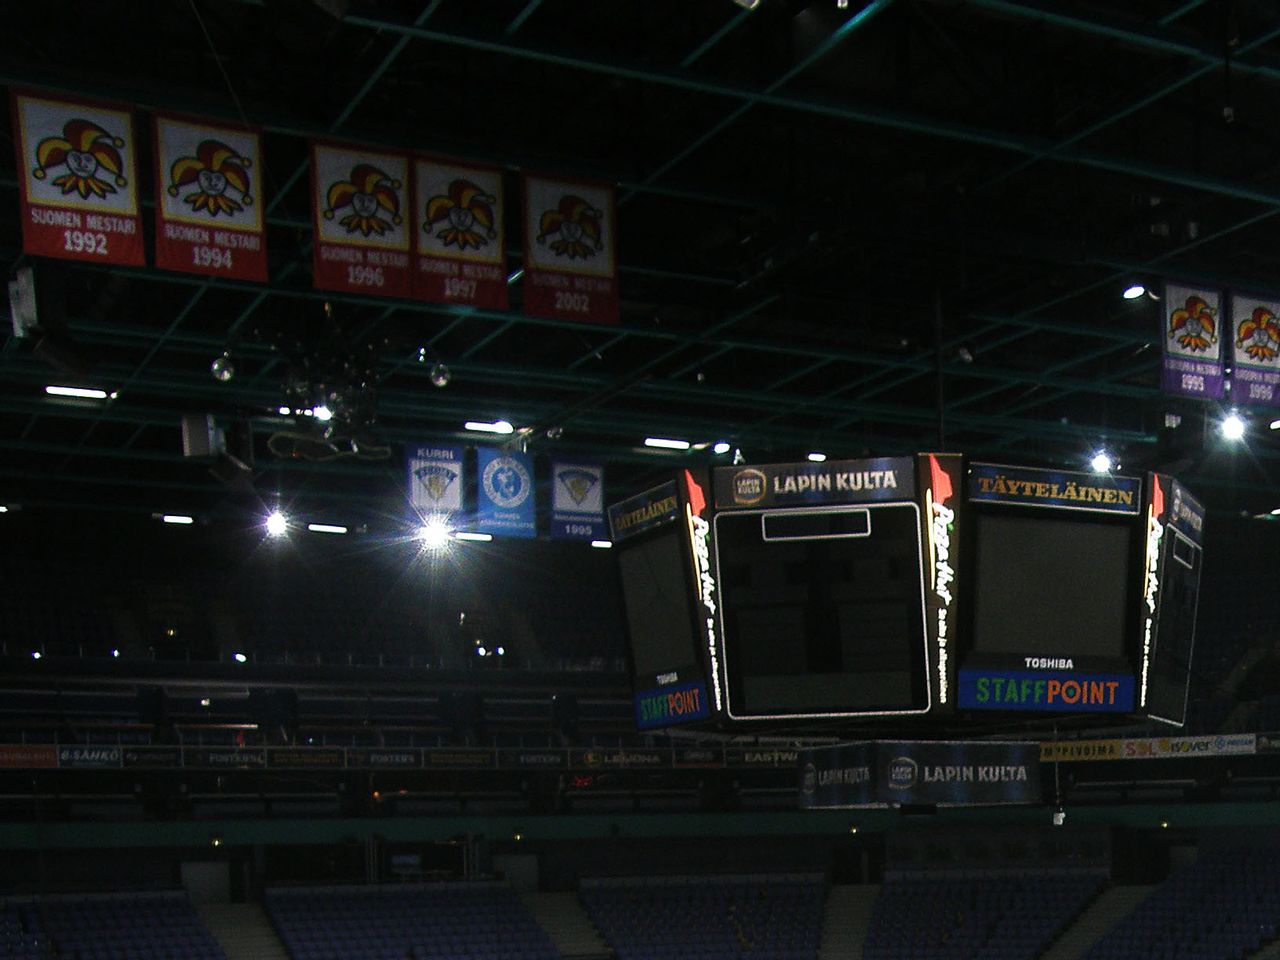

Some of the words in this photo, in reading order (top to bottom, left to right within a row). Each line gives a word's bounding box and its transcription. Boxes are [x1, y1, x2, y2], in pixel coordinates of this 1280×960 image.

[31, 207, 81, 229] SUOMEN
[86, 212, 136, 235] MESTARI
[64, 230, 108, 254] 1992
[165, 223, 209, 243] SUOMEN
[214, 231, 261, 250] MESTARI
[192, 246, 233, 270] 1994
[348, 265, 385, 287] 1996
[444, 278, 477, 299] 1997
[555, 290, 590, 312] 2002
[774, 474, 831, 494] LAPIN
[836, 470, 898, 491] KULTA
[977, 475, 1134, 505] TÄYTELÄINEN
[1025, 657, 1073, 669] TOSHIBA
[976, 677, 1119, 705] STAFFPOINT
[640, 688, 699, 720] STAFFPOINT
[924, 766, 974, 782] LAPIN
[978, 766, 1027, 782] KULTA
